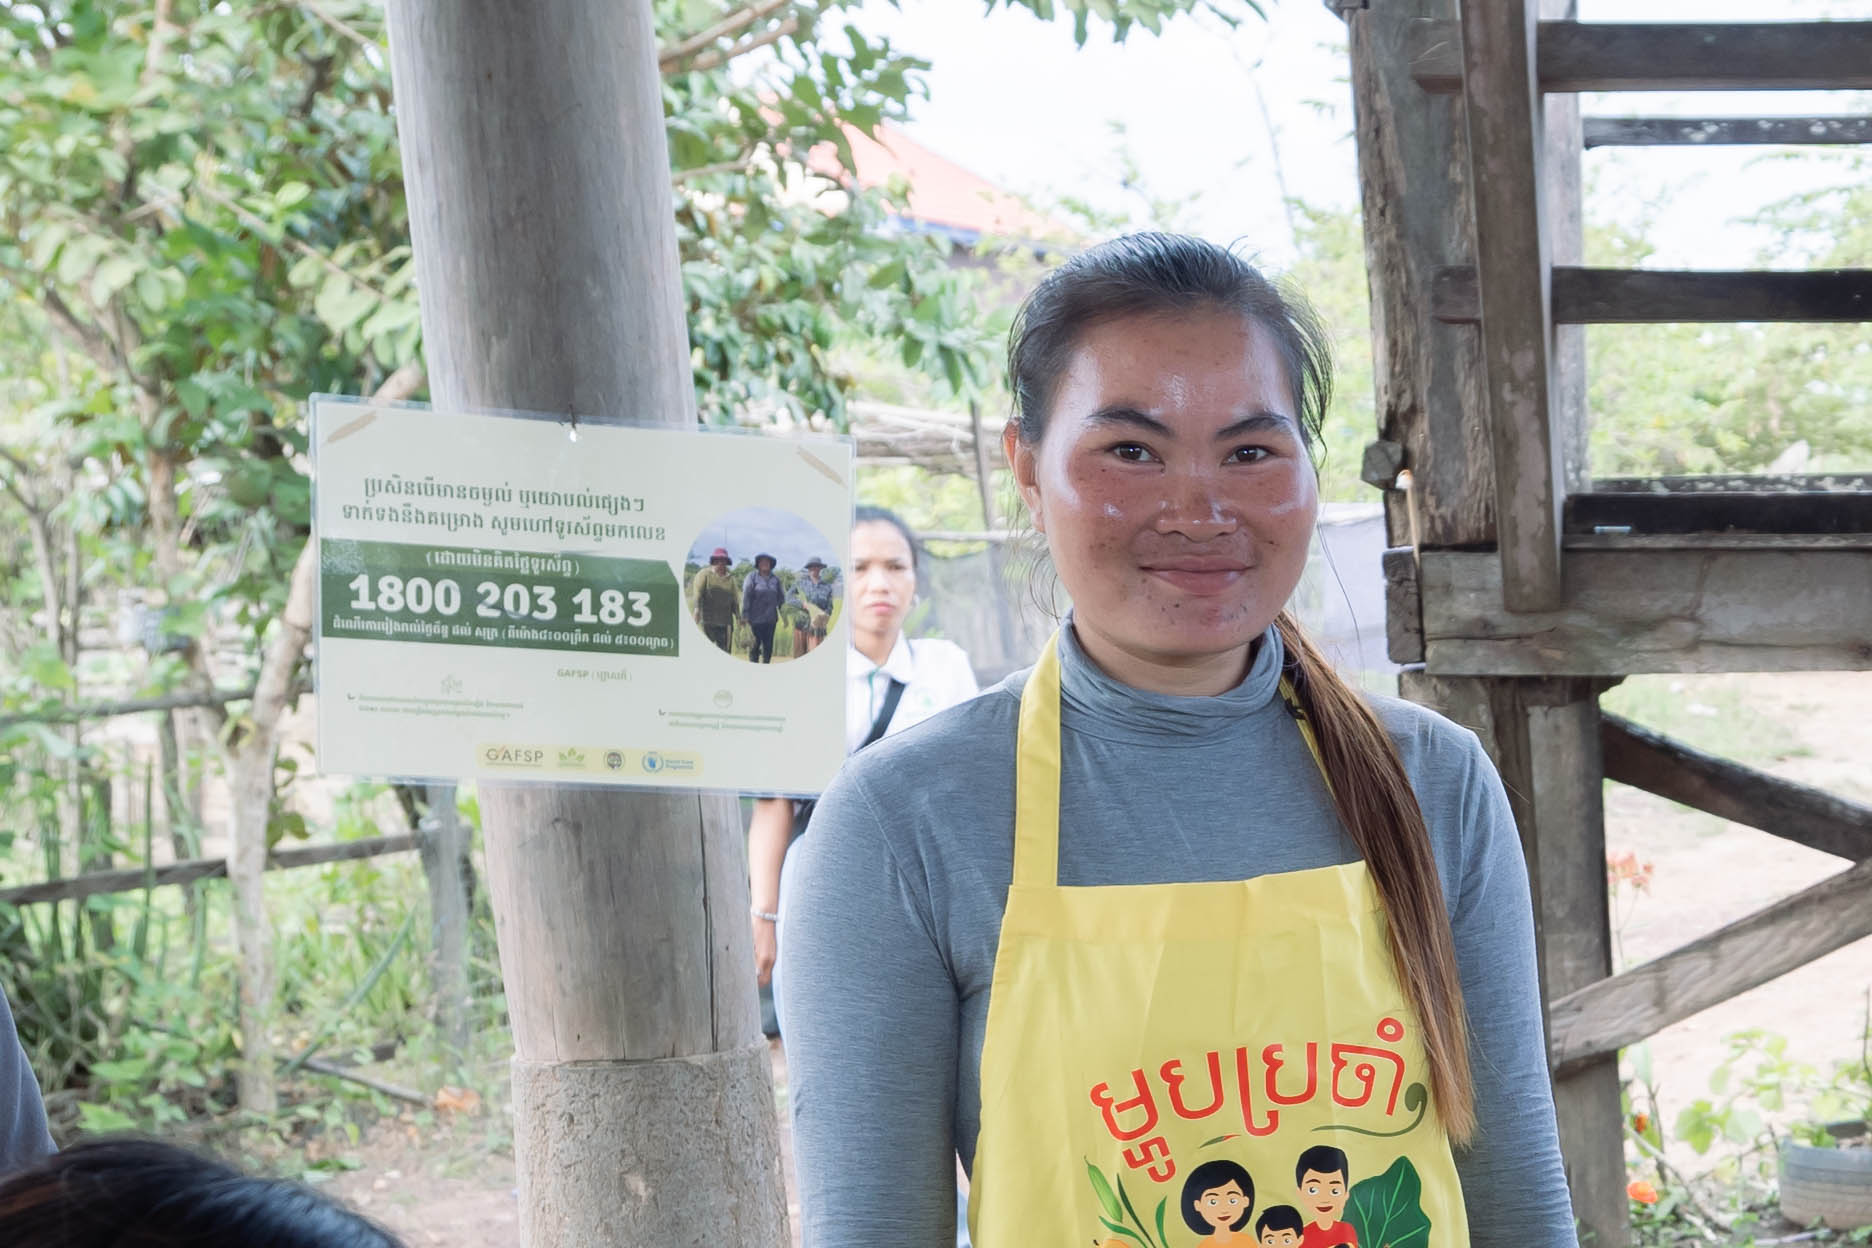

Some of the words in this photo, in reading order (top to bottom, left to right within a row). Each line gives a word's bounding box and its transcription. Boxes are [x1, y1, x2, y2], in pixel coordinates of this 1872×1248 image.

[349, 573, 461, 616] 1800
[475, 581, 558, 621] 203
[572, 587, 652, 627] 183
[556, 668, 589, 678] GAFSP
[485, 747, 544, 763] GAFSP
[1089, 1017, 1407, 1183] ម្ហូបប្រចាំ
